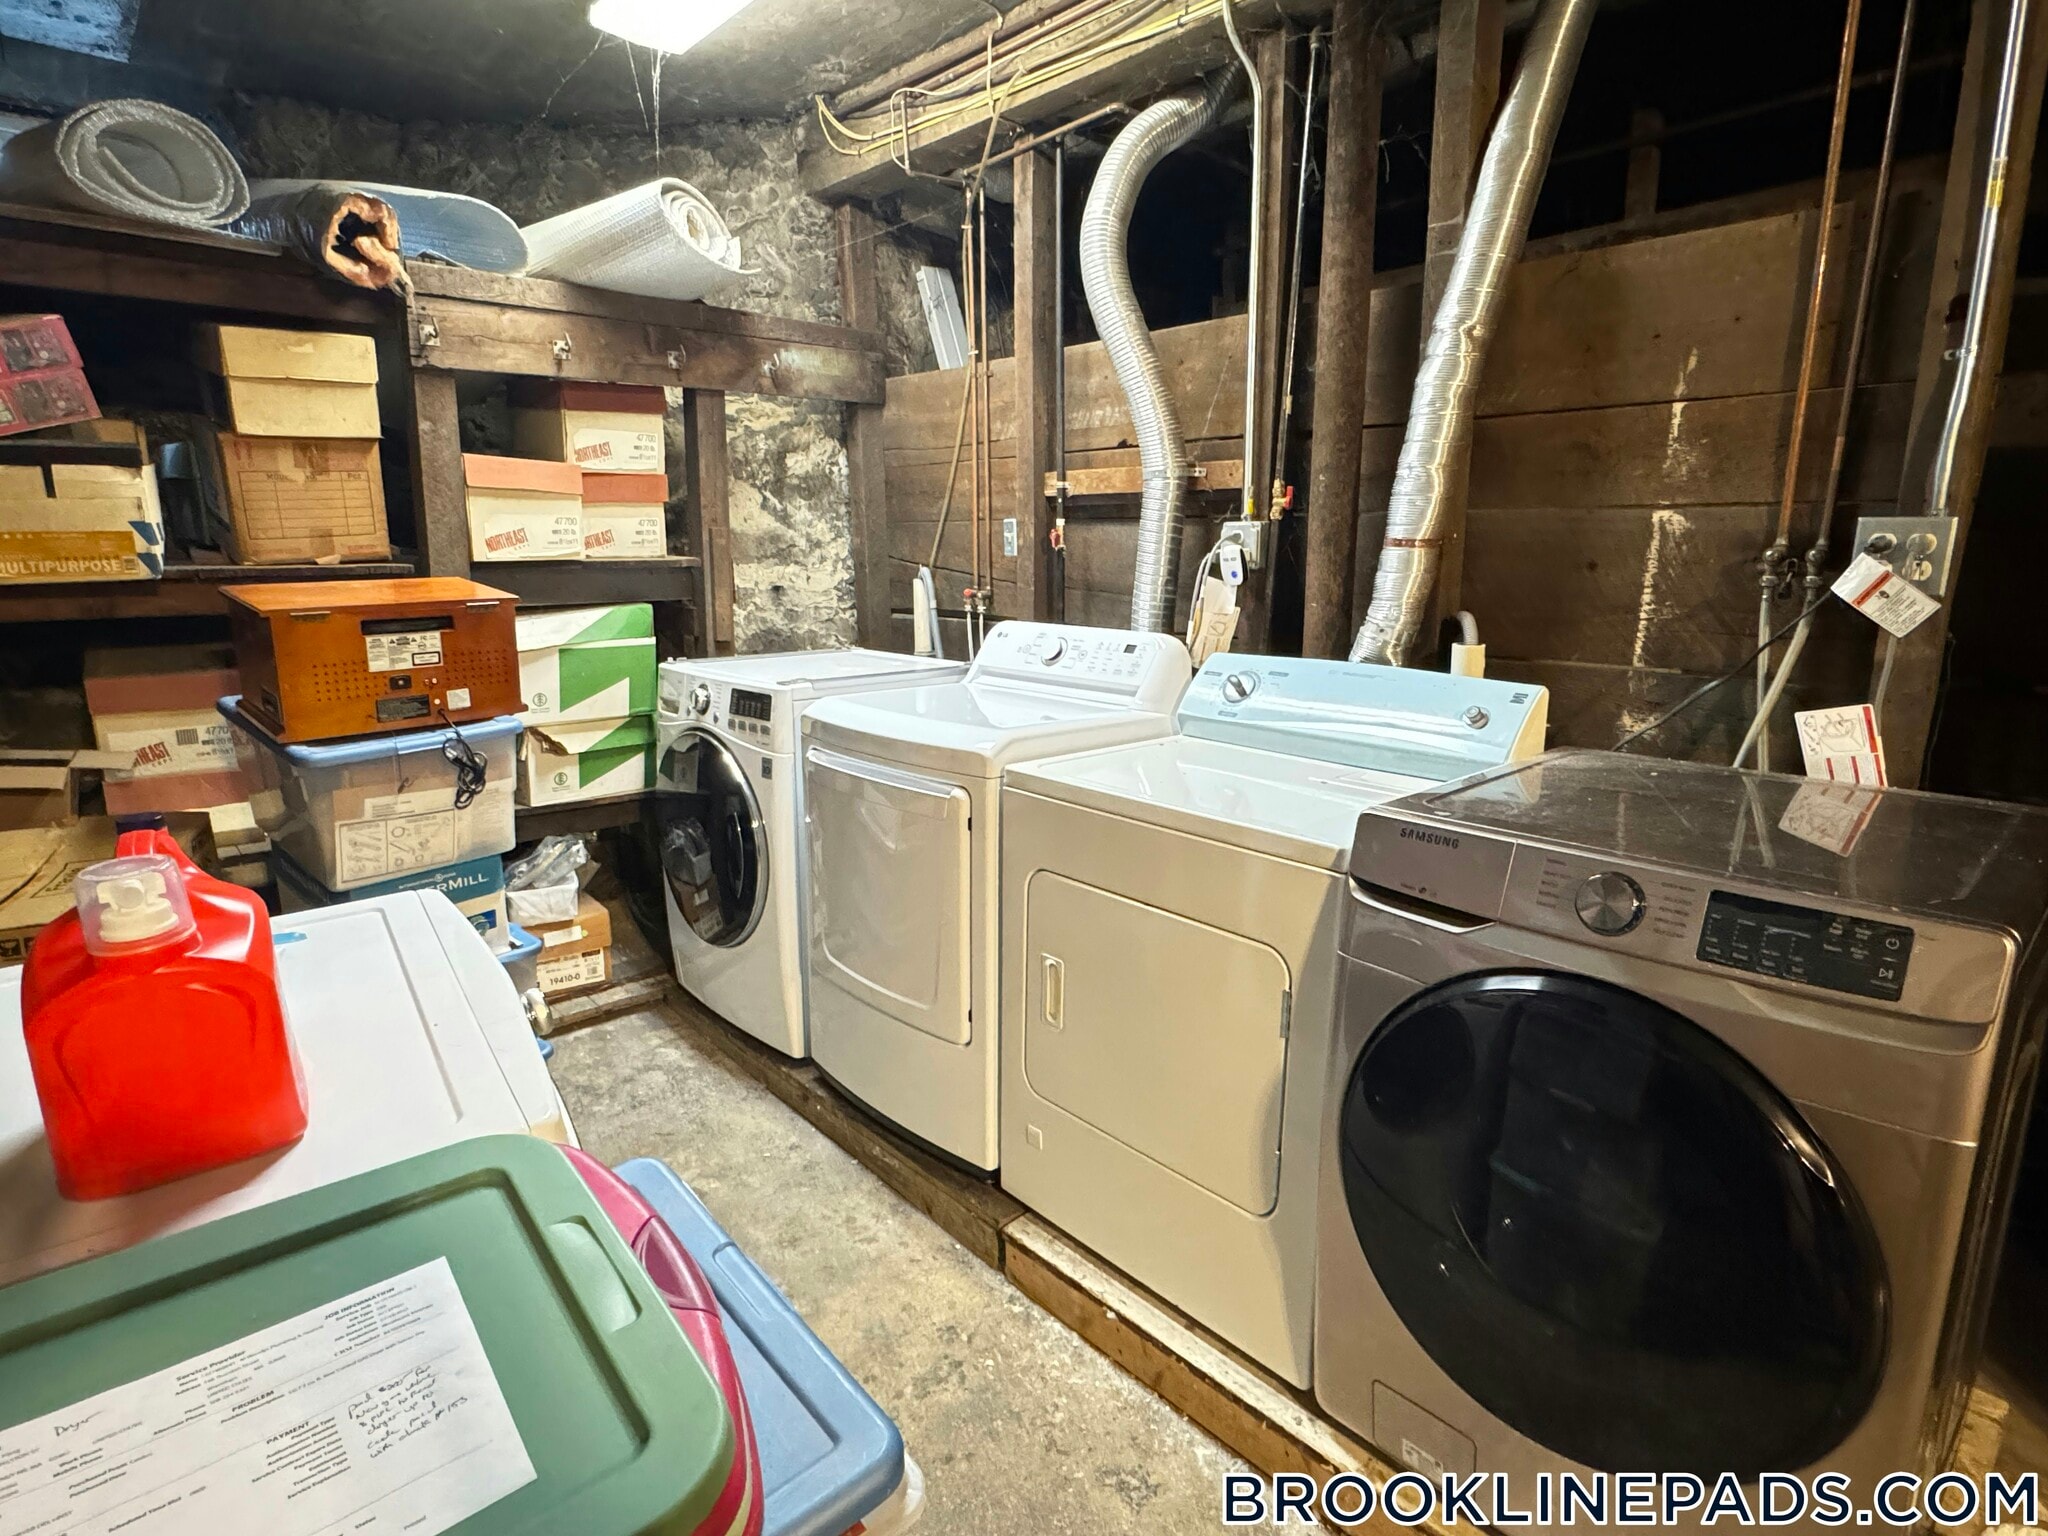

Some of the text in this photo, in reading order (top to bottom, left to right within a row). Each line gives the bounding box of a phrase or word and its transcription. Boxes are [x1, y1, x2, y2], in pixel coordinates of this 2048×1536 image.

[484, 527, 528, 553] NORTHEAST
[1400, 827, 1460, 850] SAMSUNG
[550, 973, 581, 985] 19410-0
[324, 1310, 340, 1320] JOB
[340, 1287, 396, 1312] INFORMATION
[176, 1350, 247, 1382] Service Provider
[231, 1389, 275, 1412] PROBLEM
[266, 1420, 310, 1446] PAYMENT
